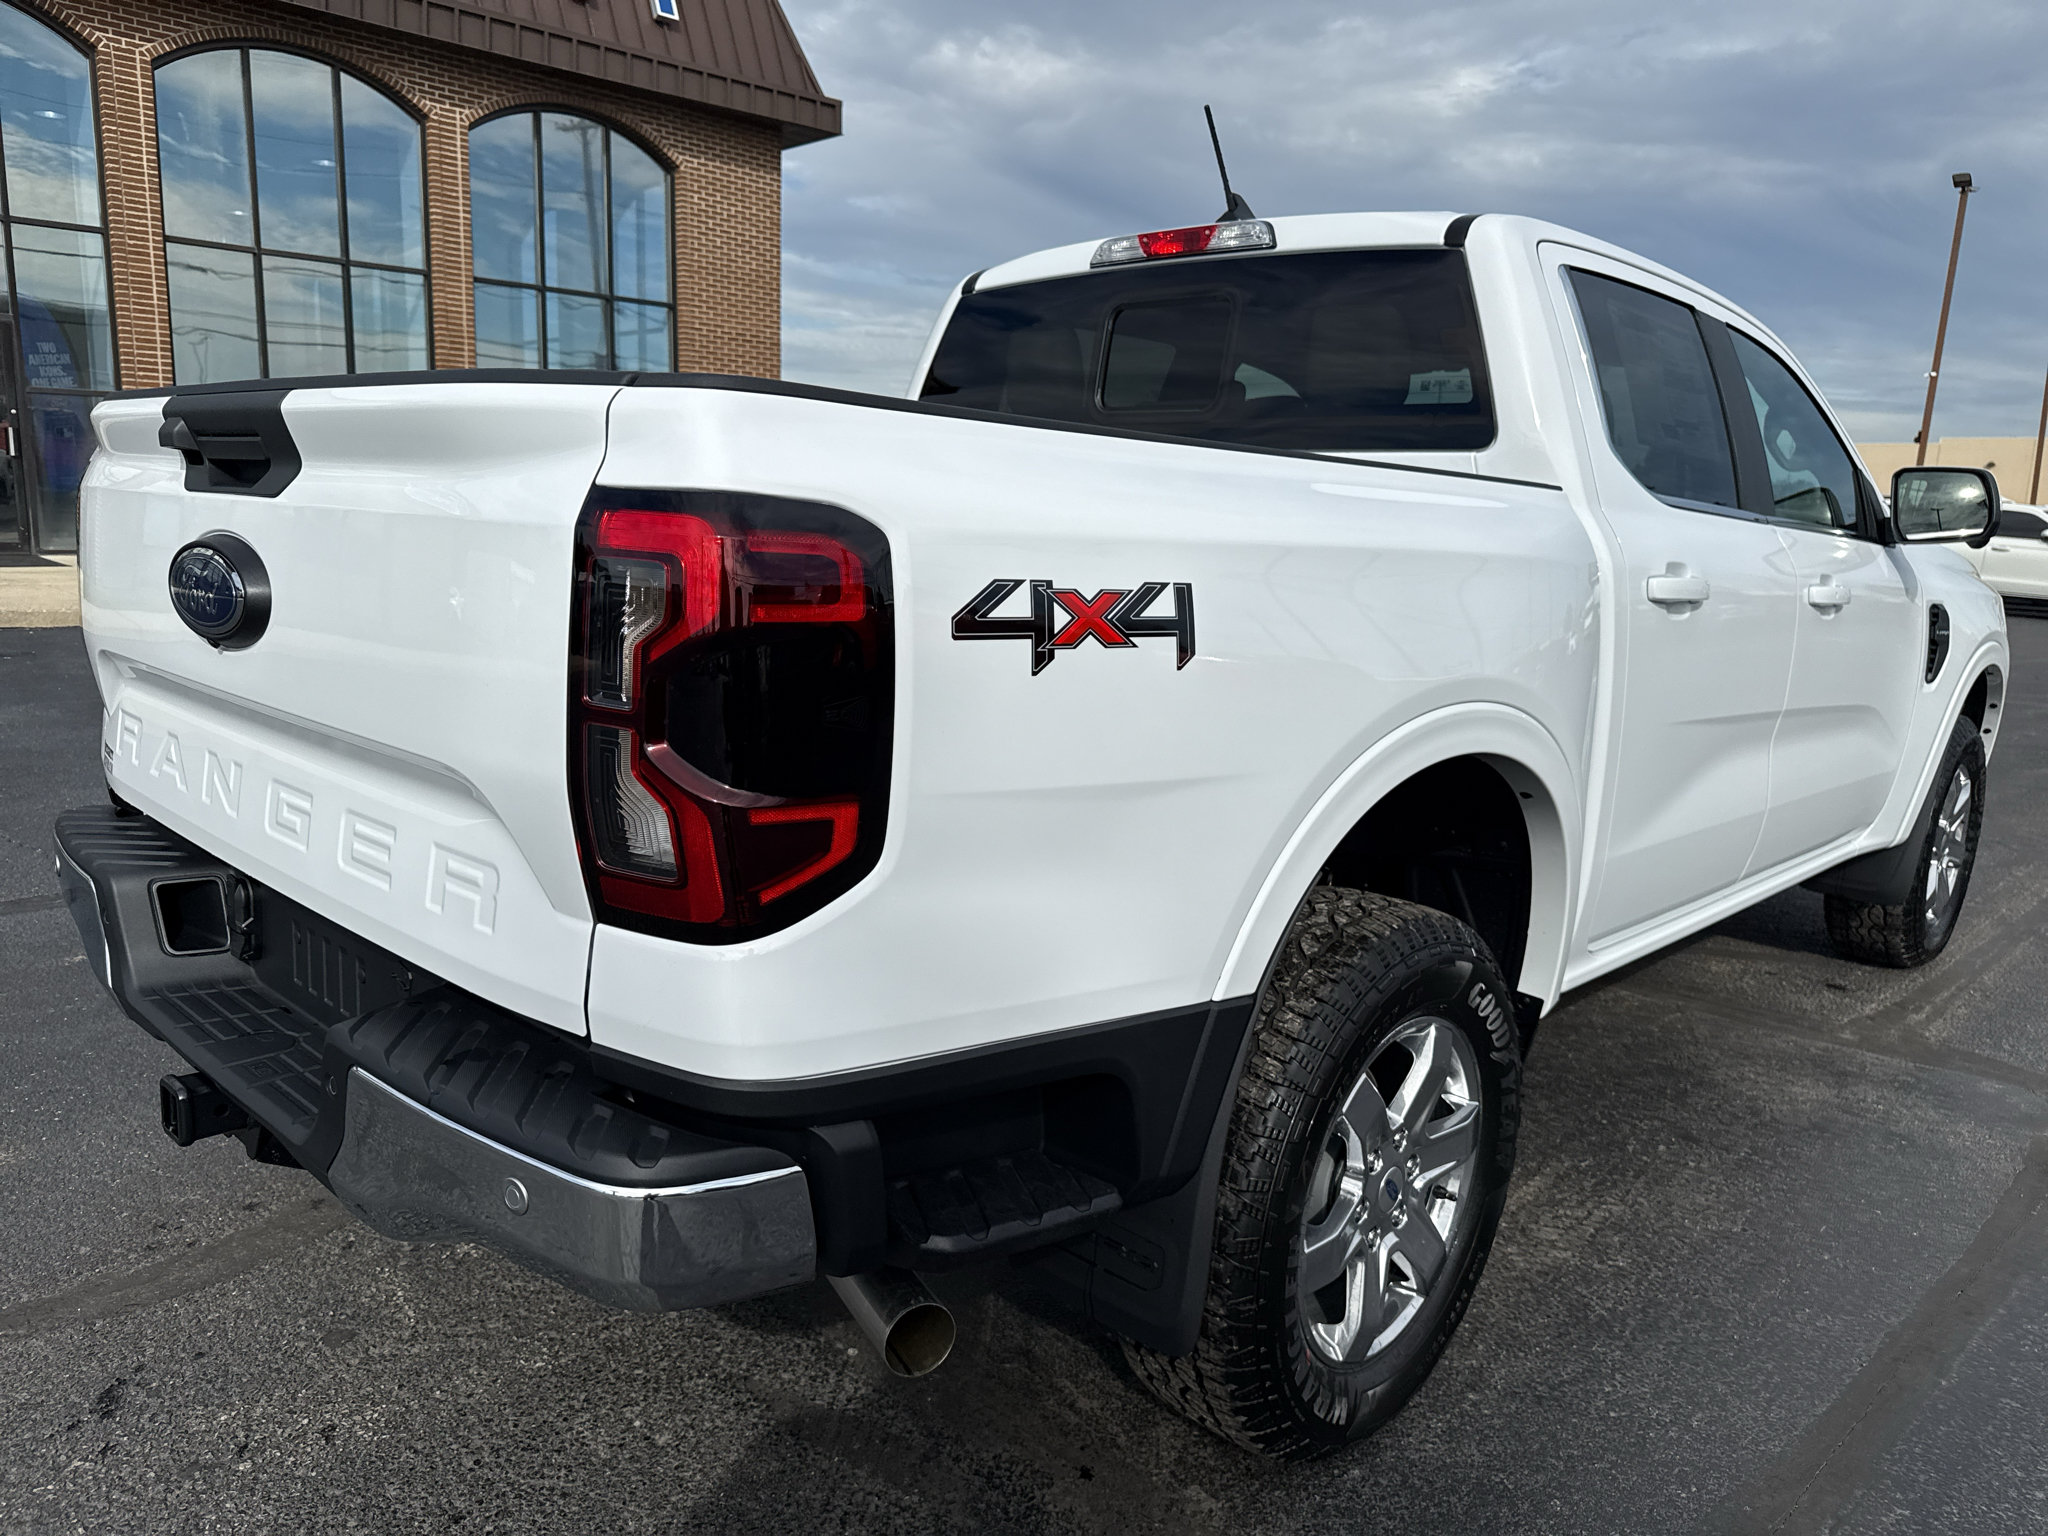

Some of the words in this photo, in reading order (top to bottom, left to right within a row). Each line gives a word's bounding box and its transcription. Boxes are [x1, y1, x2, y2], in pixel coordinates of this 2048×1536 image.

[35, 341, 57, 354] TWO
[28, 353, 72, 366] AMERICAN
[115, 707, 501, 937] RANGER
